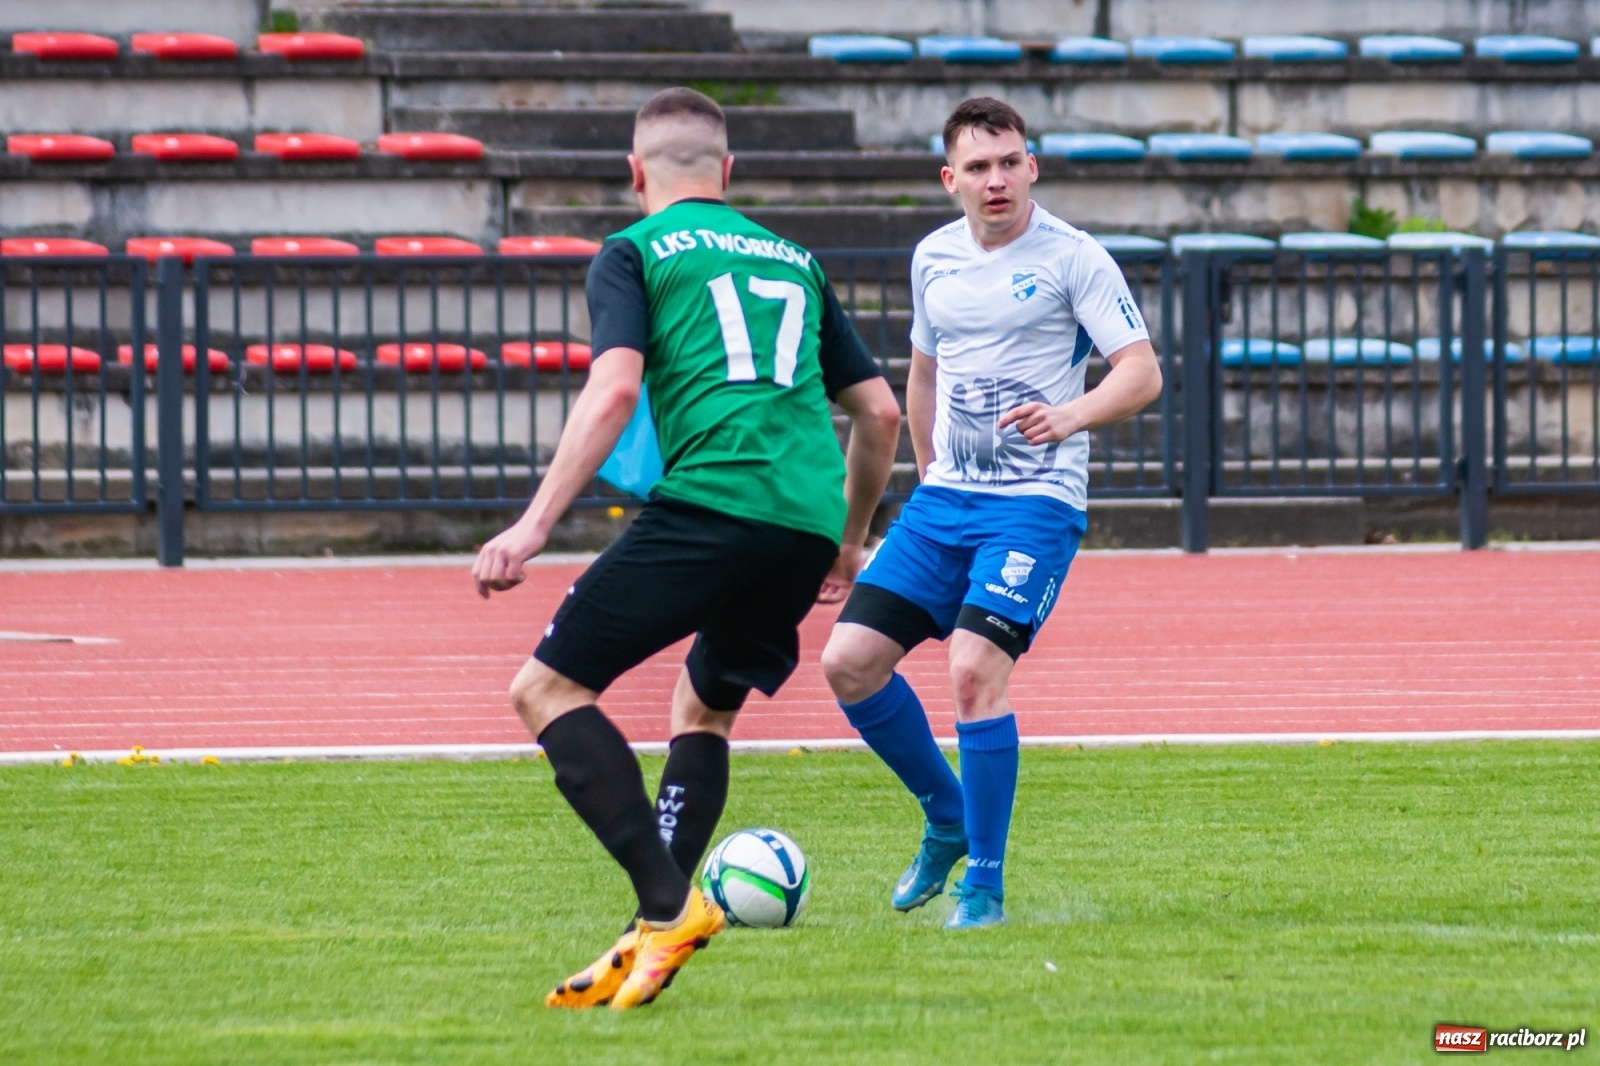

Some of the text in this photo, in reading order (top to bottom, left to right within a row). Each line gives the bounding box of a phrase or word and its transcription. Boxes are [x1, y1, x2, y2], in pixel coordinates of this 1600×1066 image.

[651, 229, 812, 271] LKS TWORKÓW
[706, 272, 807, 388] 17
[985, 582, 1029, 604] saller
